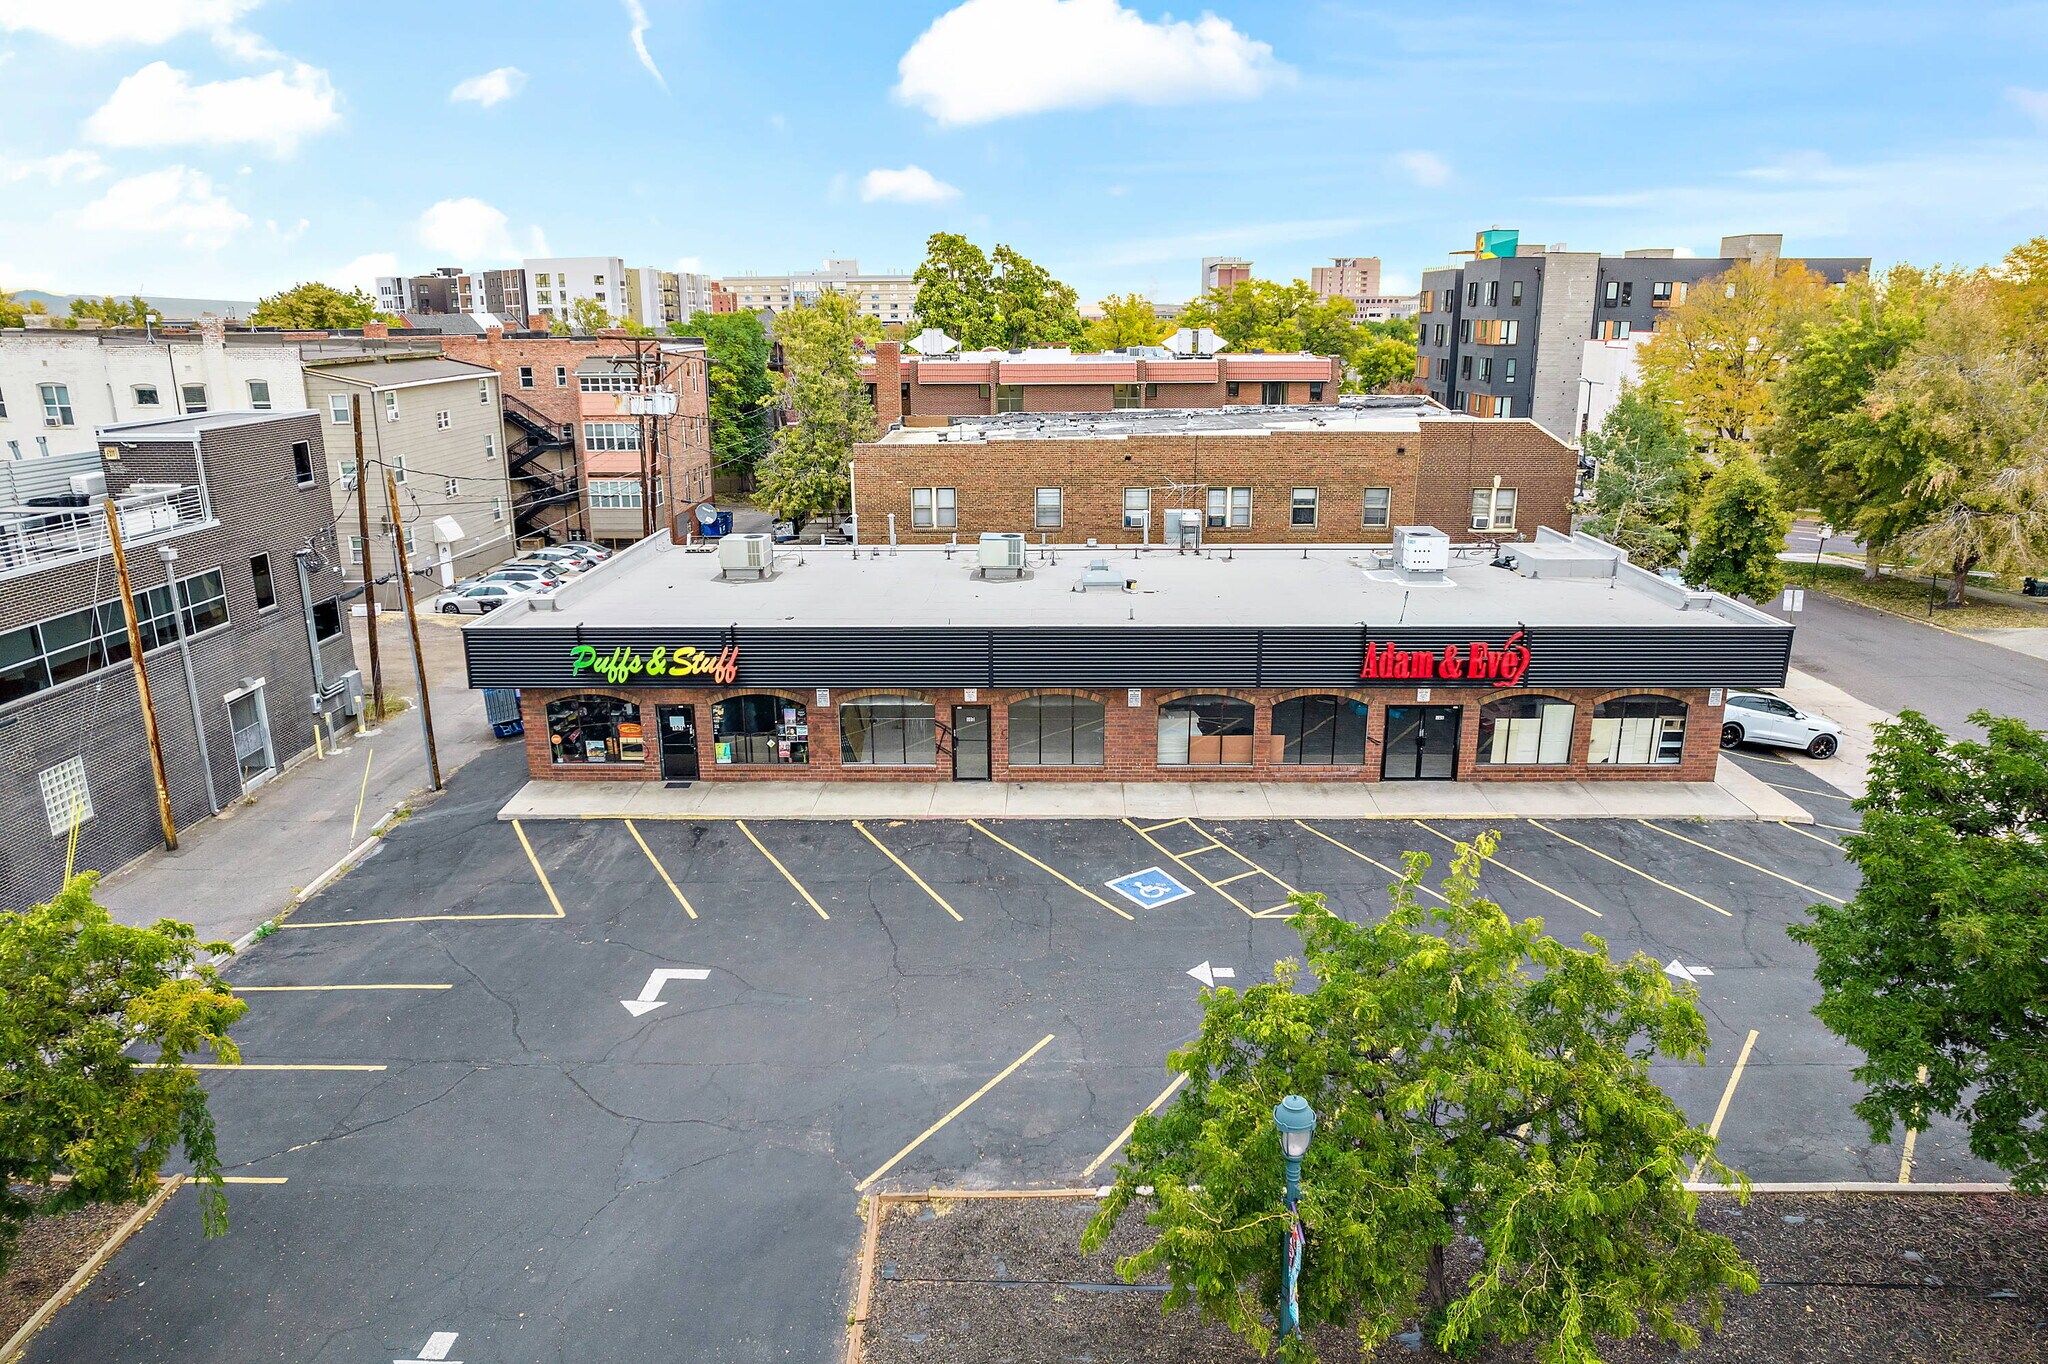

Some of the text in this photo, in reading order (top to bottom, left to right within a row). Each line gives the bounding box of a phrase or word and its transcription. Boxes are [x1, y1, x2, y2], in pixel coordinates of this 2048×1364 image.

[570, 645, 739, 684] Puffs & Stuff
[1360, 641, 1434, 679] Adam
[1439, 644, 1463, 679] &
